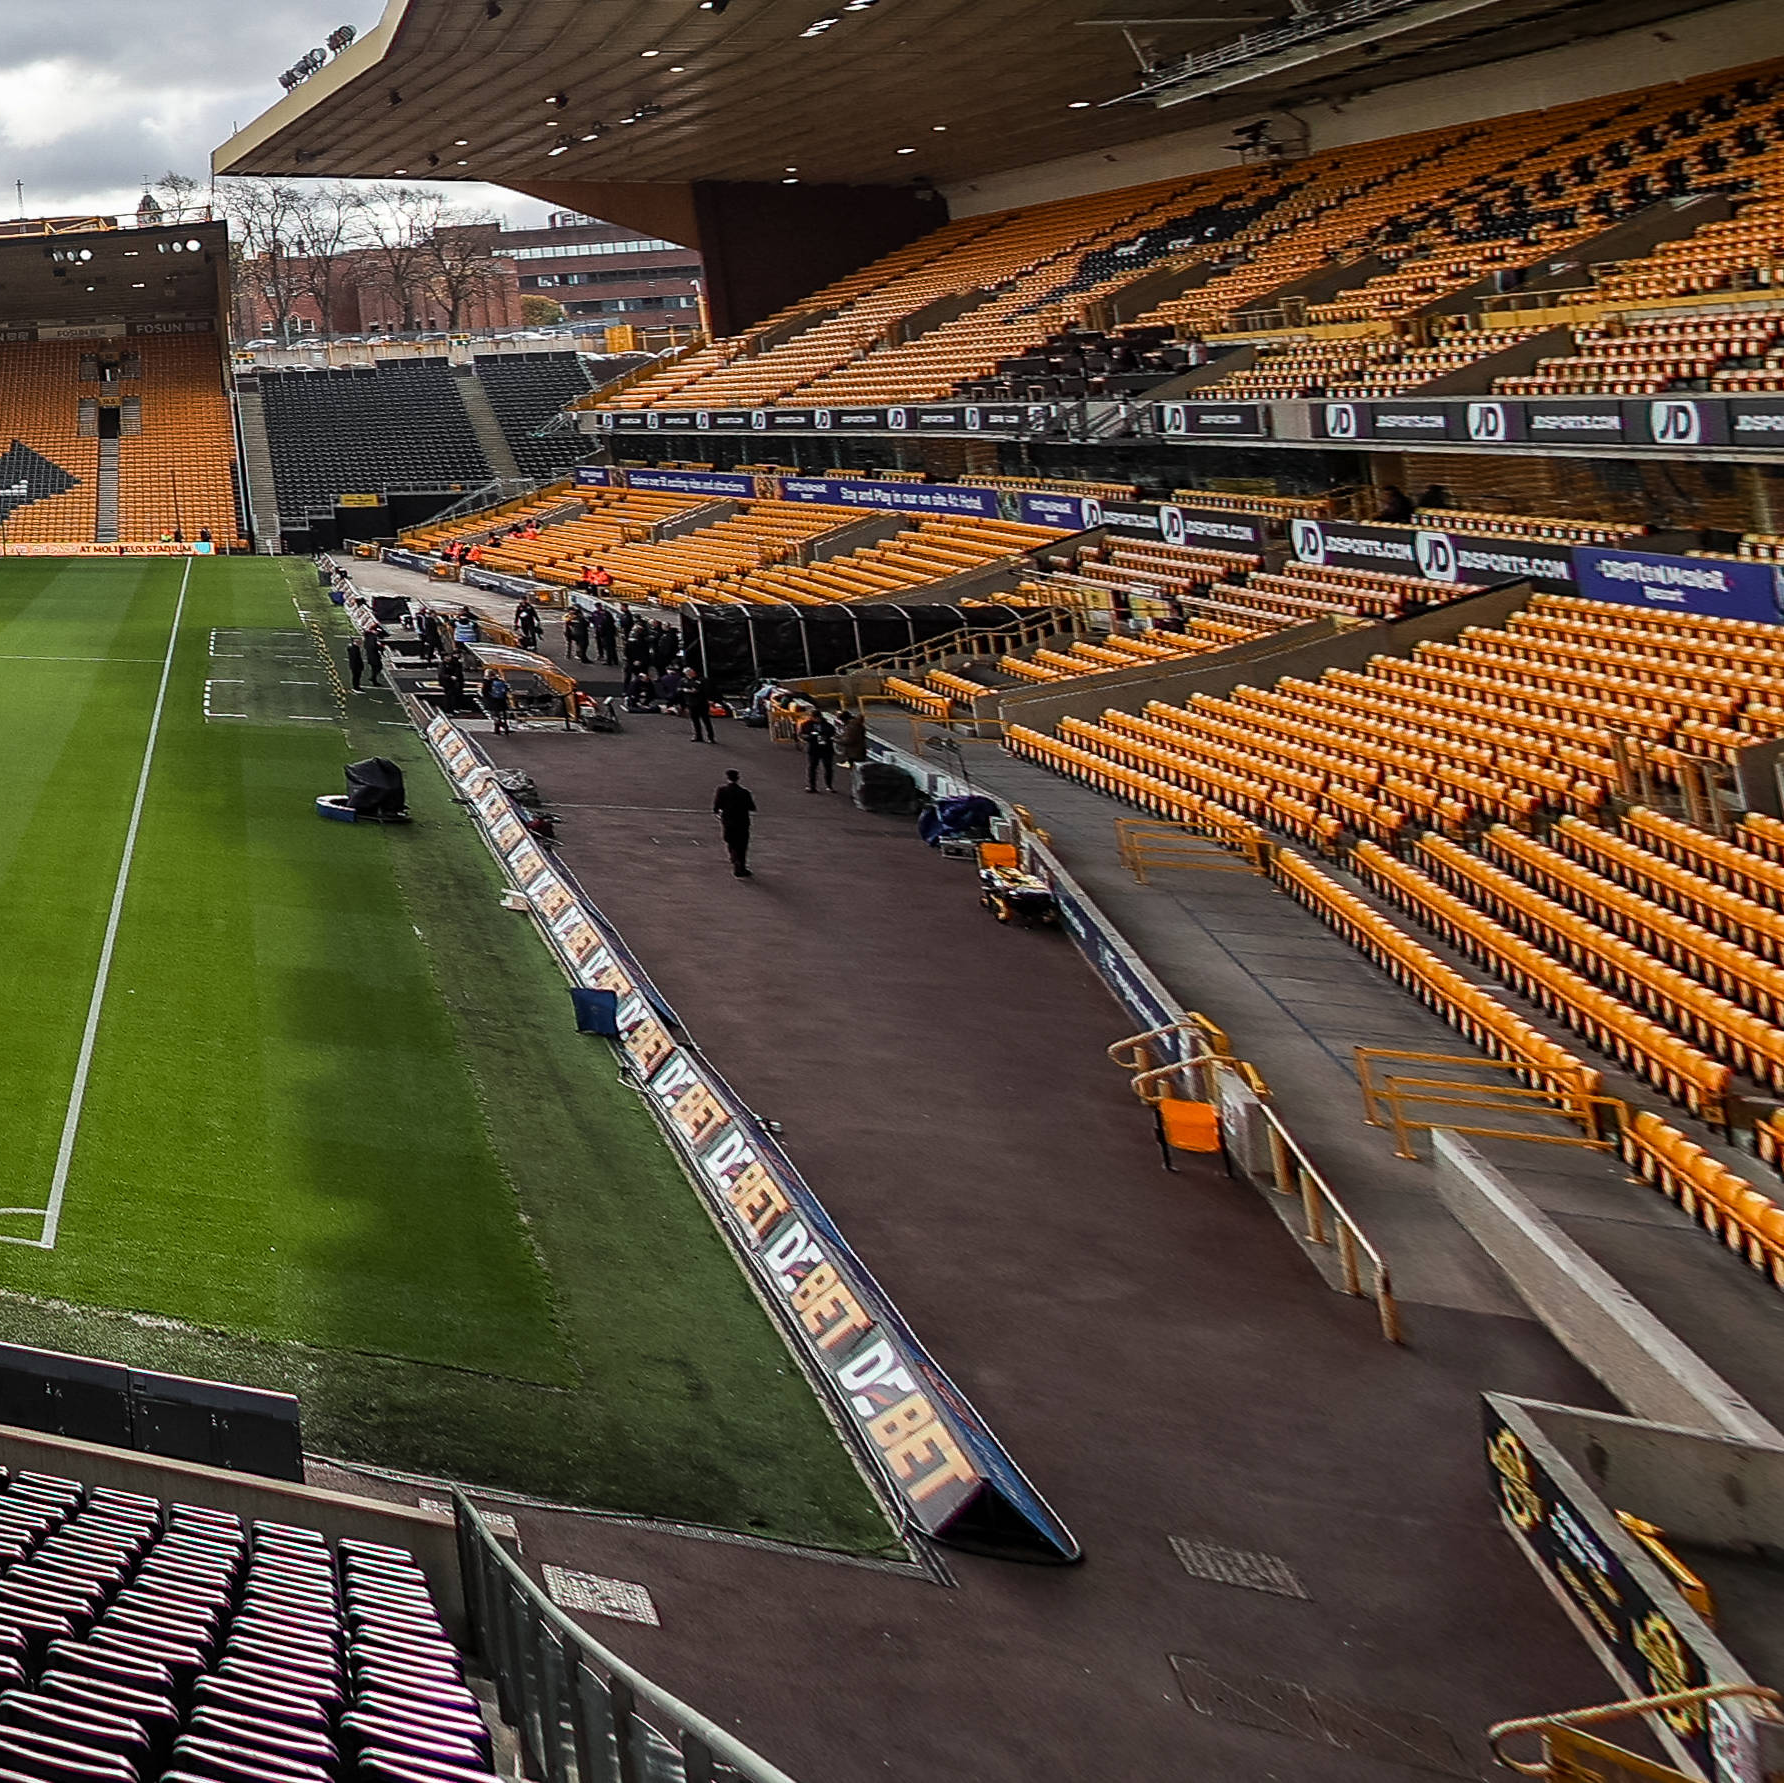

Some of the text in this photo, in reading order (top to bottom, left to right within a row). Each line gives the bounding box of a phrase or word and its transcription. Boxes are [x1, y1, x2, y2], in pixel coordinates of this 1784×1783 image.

[57, 327, 89, 337] FOSUN
[136, 322, 182, 334] FOSUN
[858, 488, 873, 500] and
[874, 488, 892, 506] Play
[146, 545, 192, 553] STADIUM
[1325, 535, 1413, 560] JDSPORTS.COM
[1457, 550, 1569, 580] JDSPORTS.COM
[616, 997, 675, 1081] DEBET
[653, 1056, 731, 1144] DEBET
[705, 1130, 792, 1239] DEBET
[764, 1221, 874, 1350] DEBET
[837, 1338, 979, 1503] DEBET
